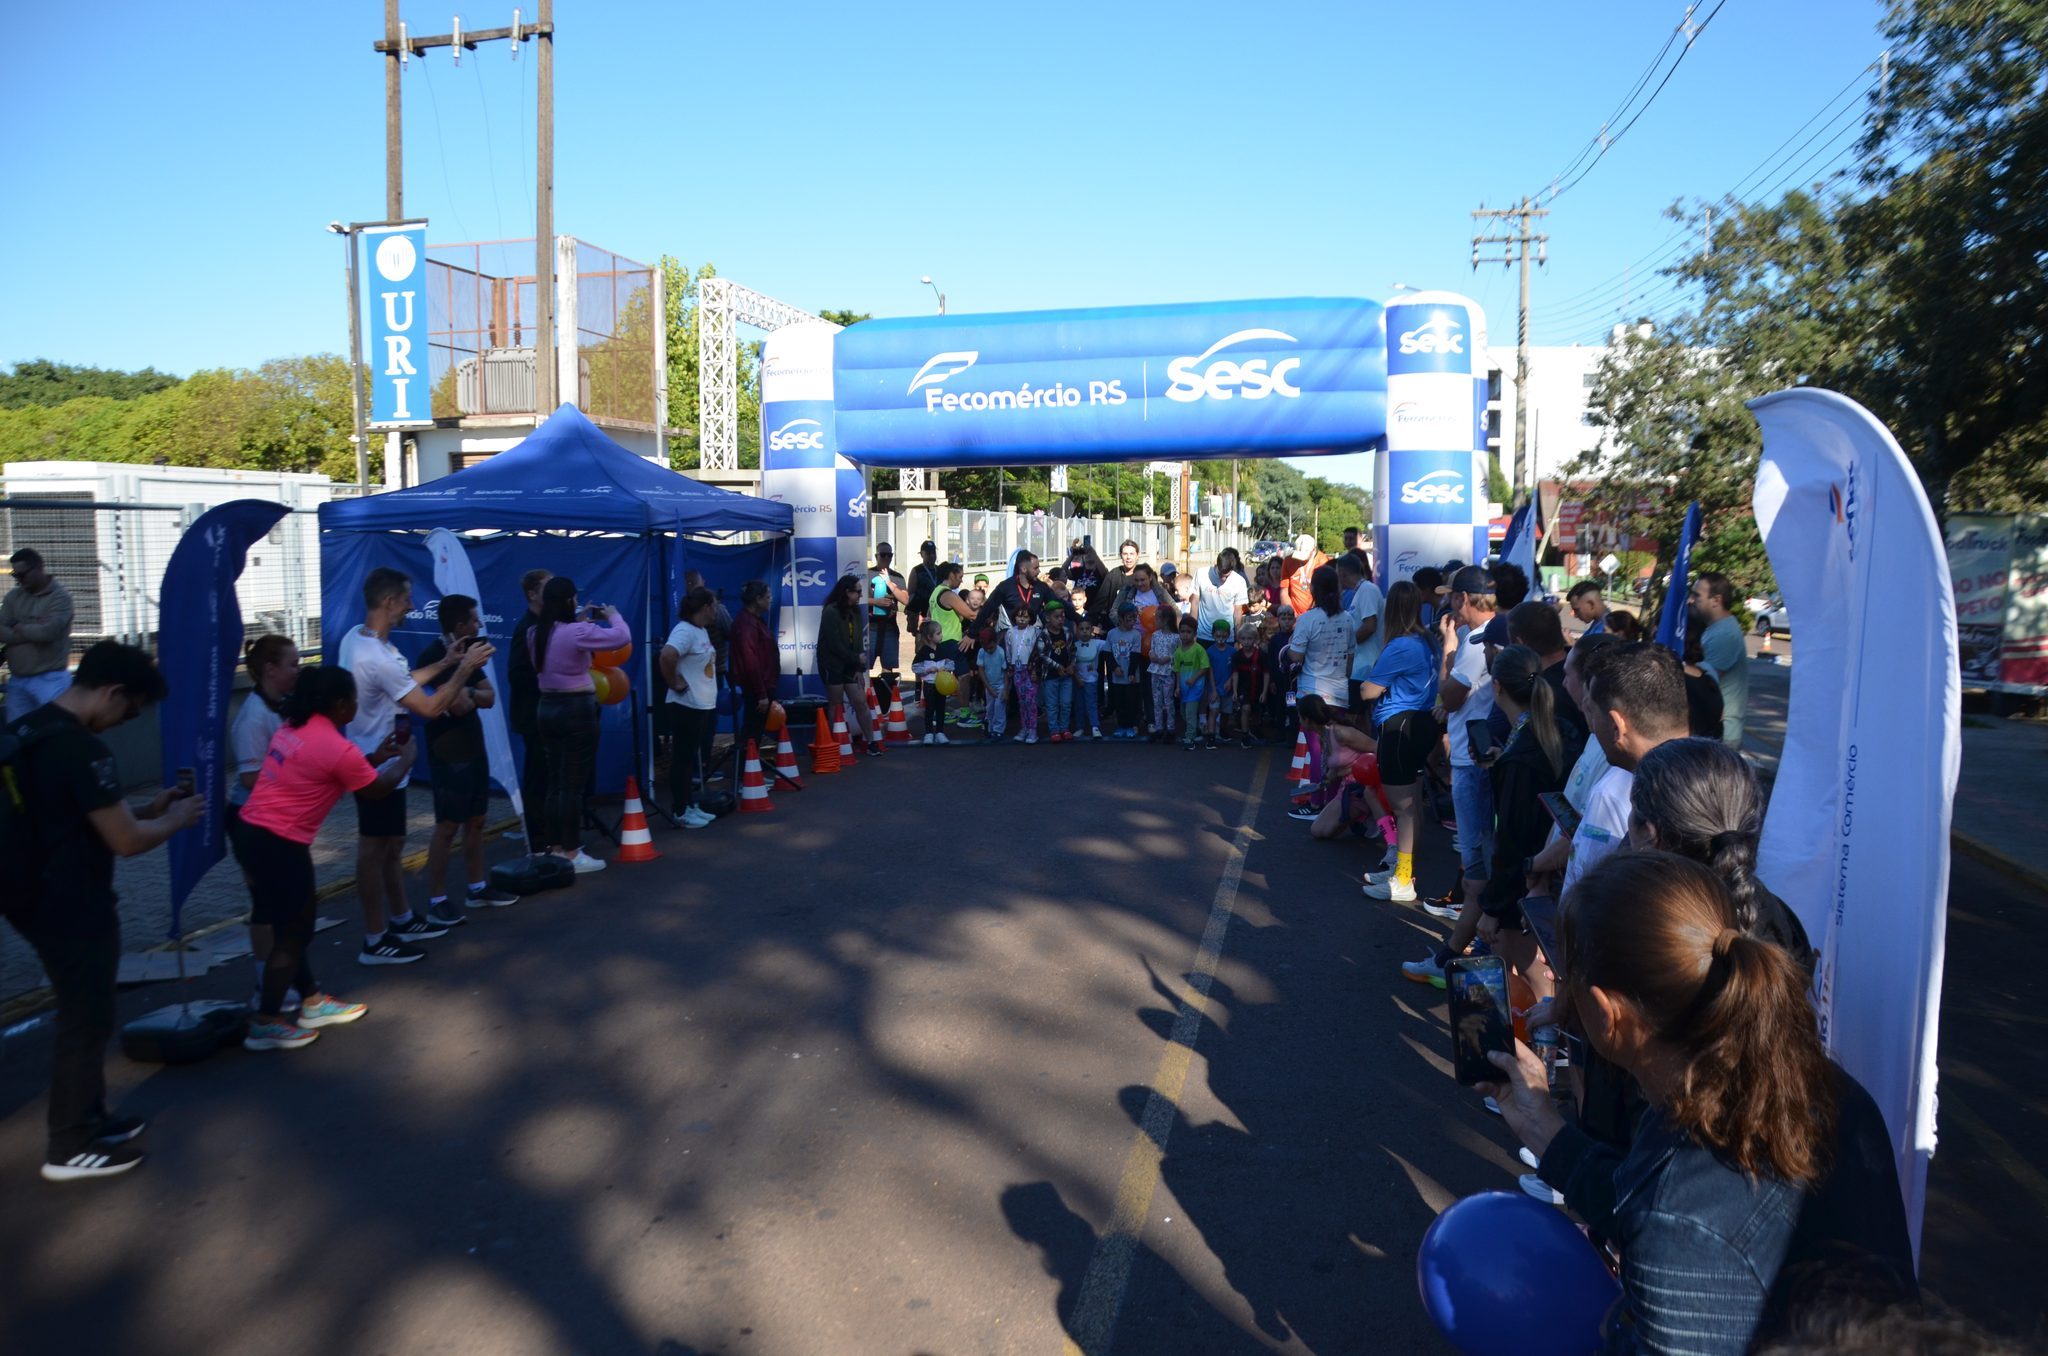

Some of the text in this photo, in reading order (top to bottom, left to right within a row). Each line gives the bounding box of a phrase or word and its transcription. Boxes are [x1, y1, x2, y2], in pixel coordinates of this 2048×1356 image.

[381, 291, 417, 418] URI
[925, 380, 1127, 413] Fecomércio RS
[819, 504, 833, 513] RS
[1835, 744, 1858, 926] Sistema Comércio
